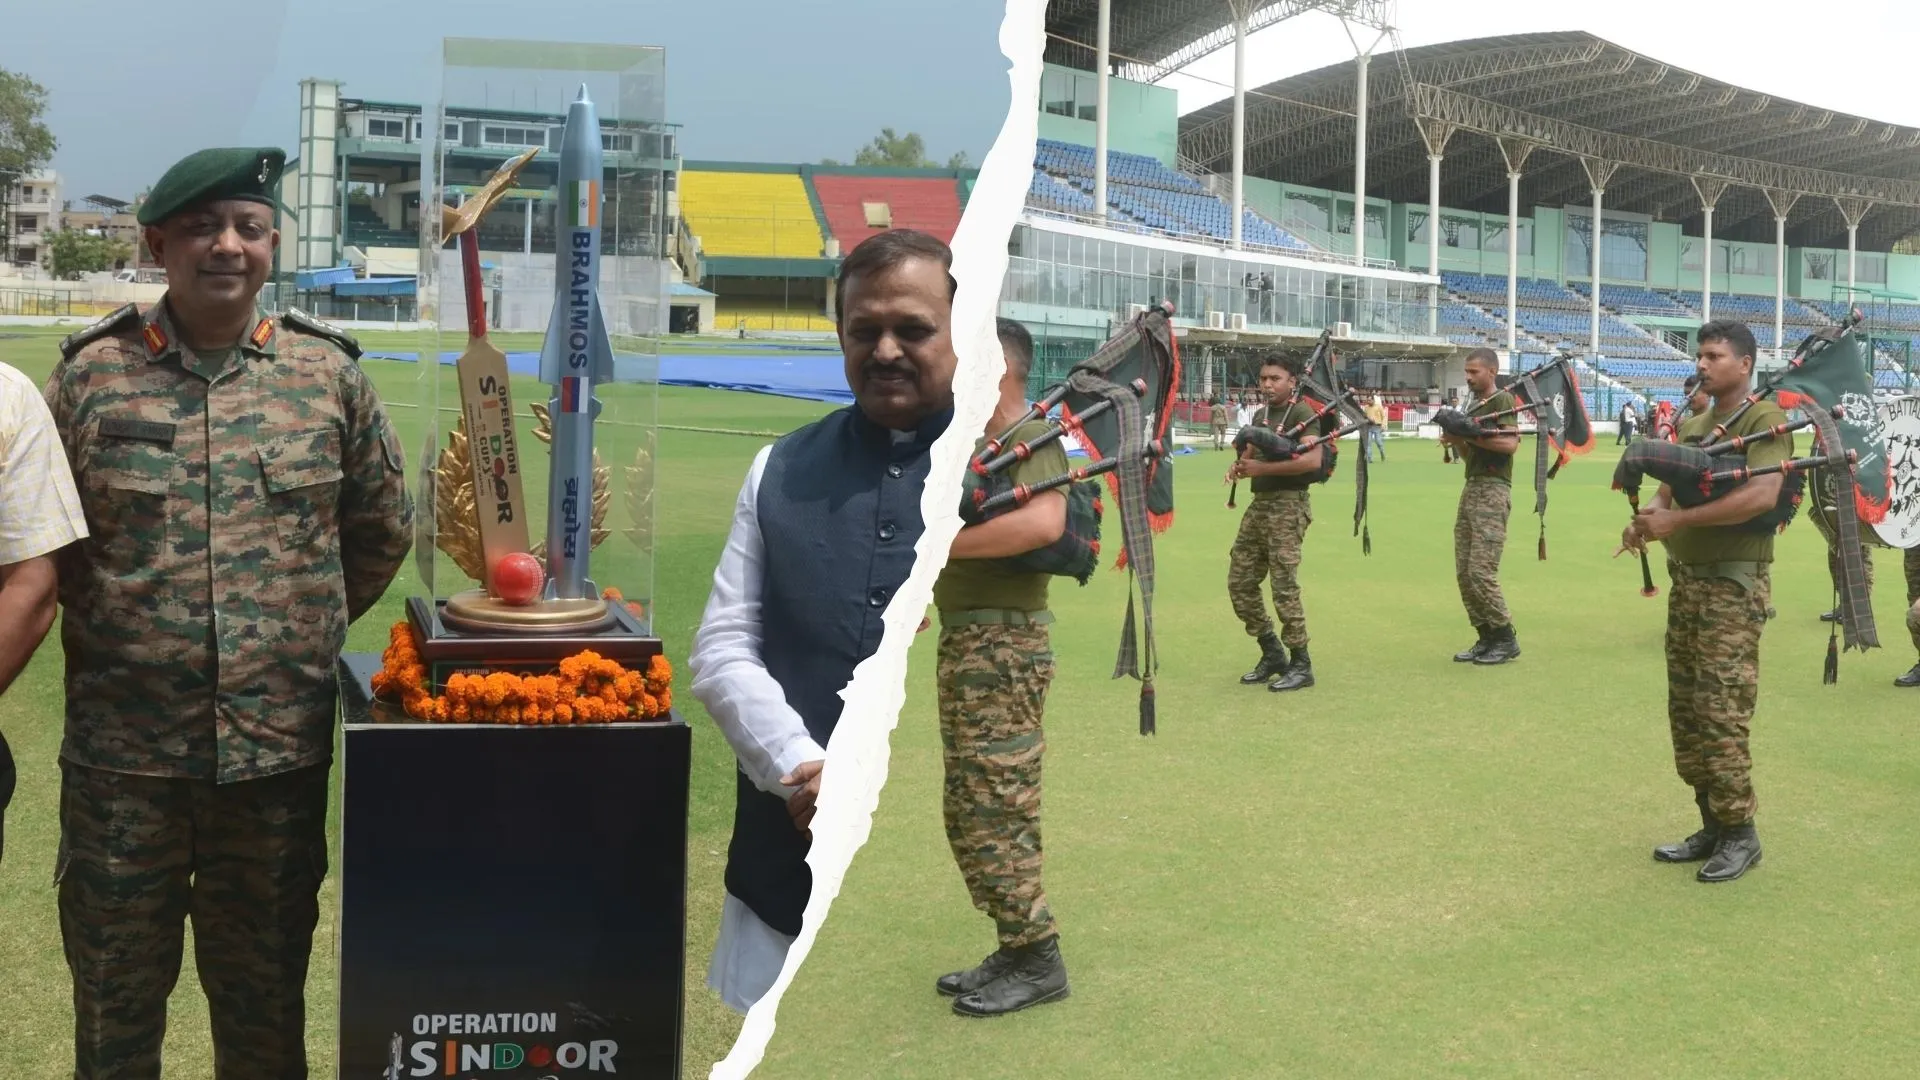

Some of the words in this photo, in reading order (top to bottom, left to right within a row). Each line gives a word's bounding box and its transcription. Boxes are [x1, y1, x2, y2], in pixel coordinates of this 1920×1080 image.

[569, 232, 591, 370] BRAHMOS
[498, 385, 517, 474] OPERATION
[412, 1012, 557, 1035] OPERATION
[409, 1039, 619, 1077] SINDOOR
